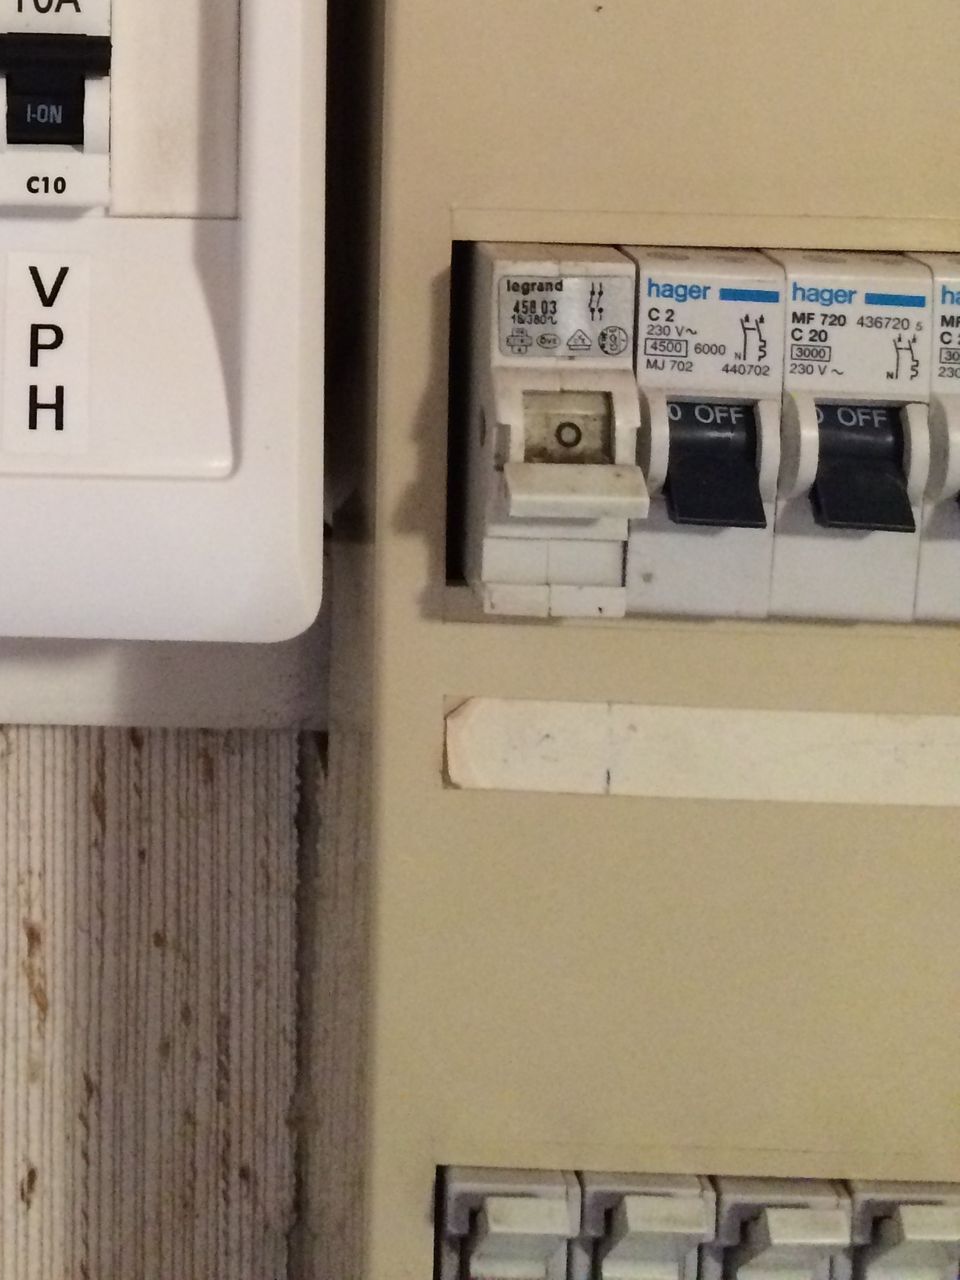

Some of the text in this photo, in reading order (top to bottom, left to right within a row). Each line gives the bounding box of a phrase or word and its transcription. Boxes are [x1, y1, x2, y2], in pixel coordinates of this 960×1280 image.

[26, 175, 67, 194] C10
[506, 279, 564, 296] legrand
[647, 278, 711, 303] hager
[792, 281, 858, 307] hager
[541, 299, 557, 315] 03
[647, 307, 675, 323] C 2
[791, 311, 815, 326] MF
[820, 313, 846, 328] 720
[856, 315, 910, 331] 436720
[646, 324, 671, 337] 230
[791, 328, 828, 343] C 20
[940, 331, 952, 345] C
[650, 341, 727, 356] 4500 6000
[795, 347, 827, 360] 3000
[646, 358, 693, 373] MJ 702
[721, 363, 770, 377] 440702
[789, 363, 827, 376] 230 V
[694, 404, 745, 424] OFF
[837, 407, 887, 428] OFF
